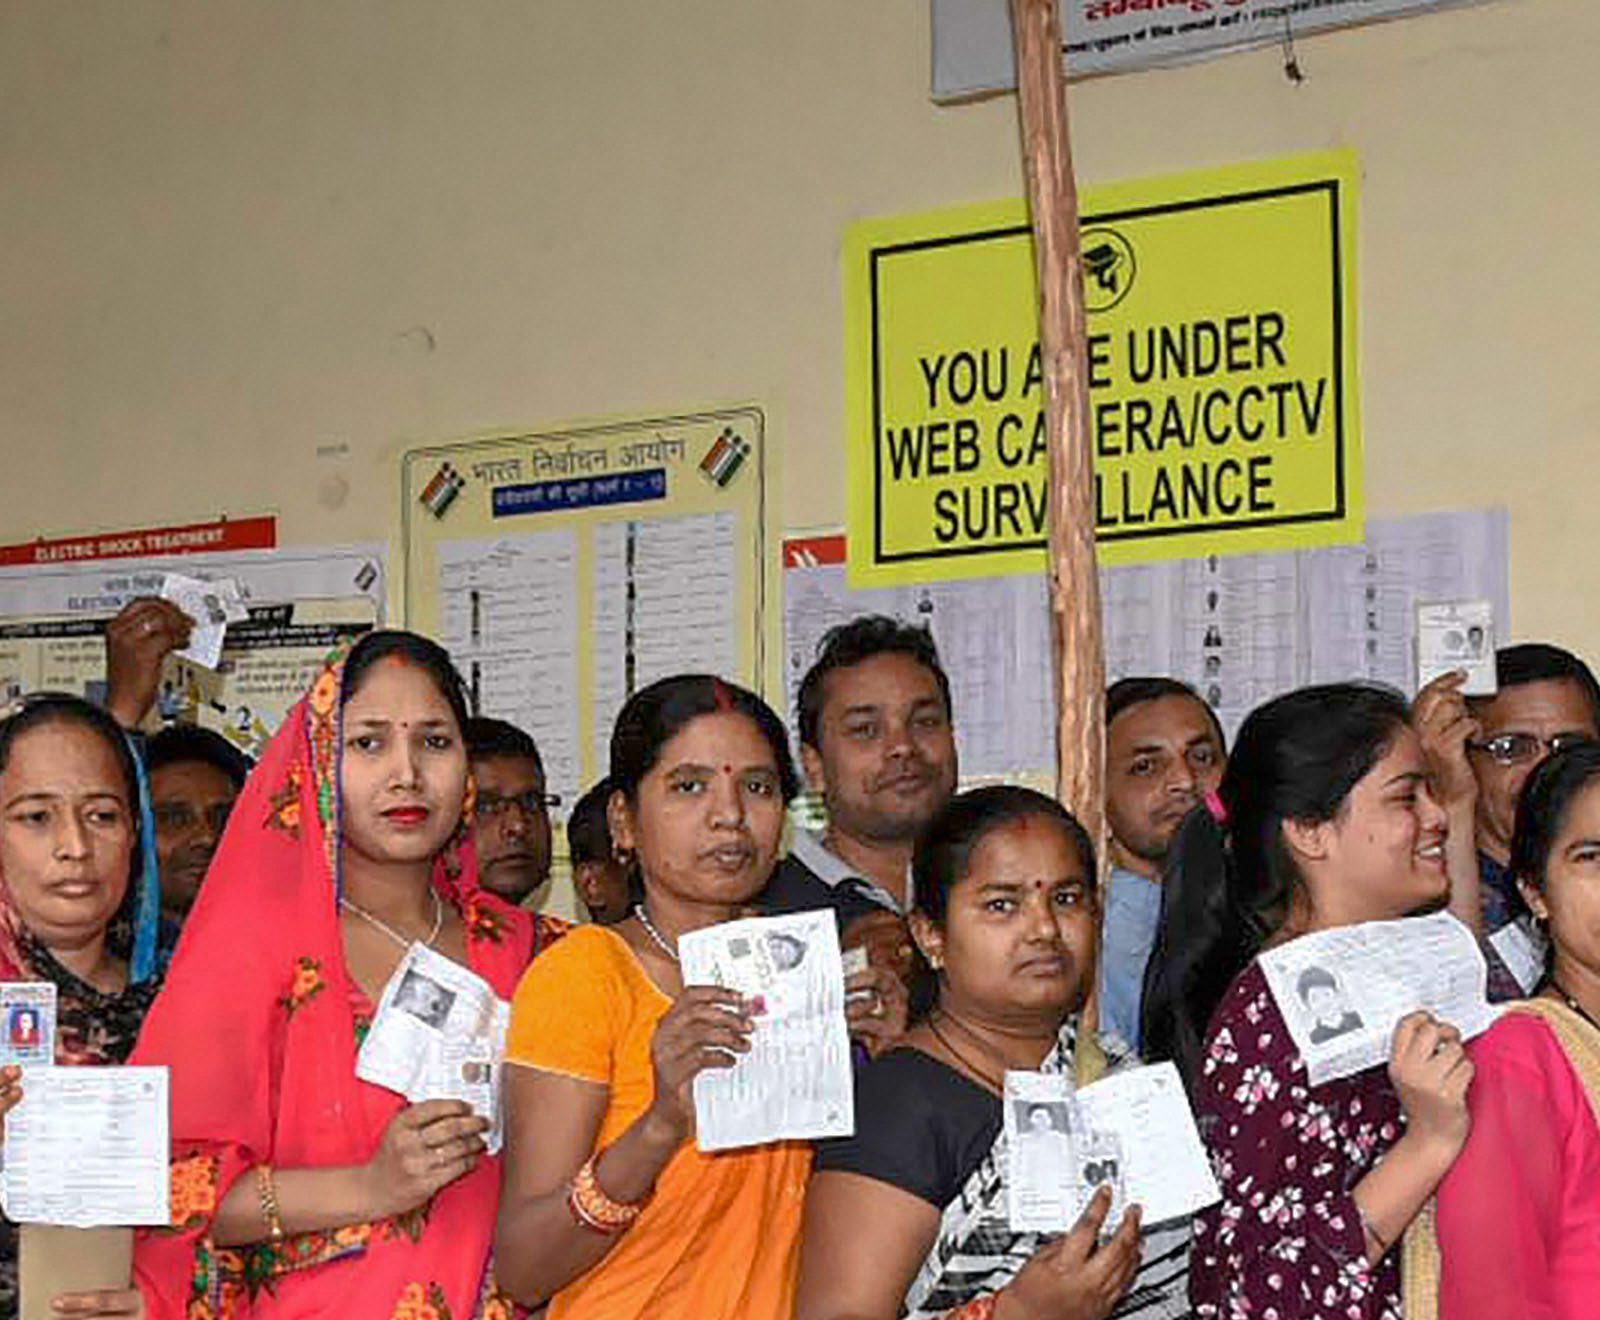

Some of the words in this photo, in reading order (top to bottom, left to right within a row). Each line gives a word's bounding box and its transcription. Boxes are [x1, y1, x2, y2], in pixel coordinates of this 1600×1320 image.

[919, 348, 1008, 408] YOU
[1021, 333, 1112, 398] AE
[1128, 311, 1288, 383] UNDER
[472, 457, 523, 484] भारत
[533, 440, 608, 475] निर्वाचन
[619, 431, 686, 468] आयोग
[886, 419, 980, 481] WEB
[998, 377, 1328, 468] CAERA/CCTV
[933, 455, 1276, 543] SURVLLANCE
[35, 542, 96, 562] ELECTRIC
[99, 537, 144, 555] SHOCK
[146, 528, 225, 551] TREATMENT
